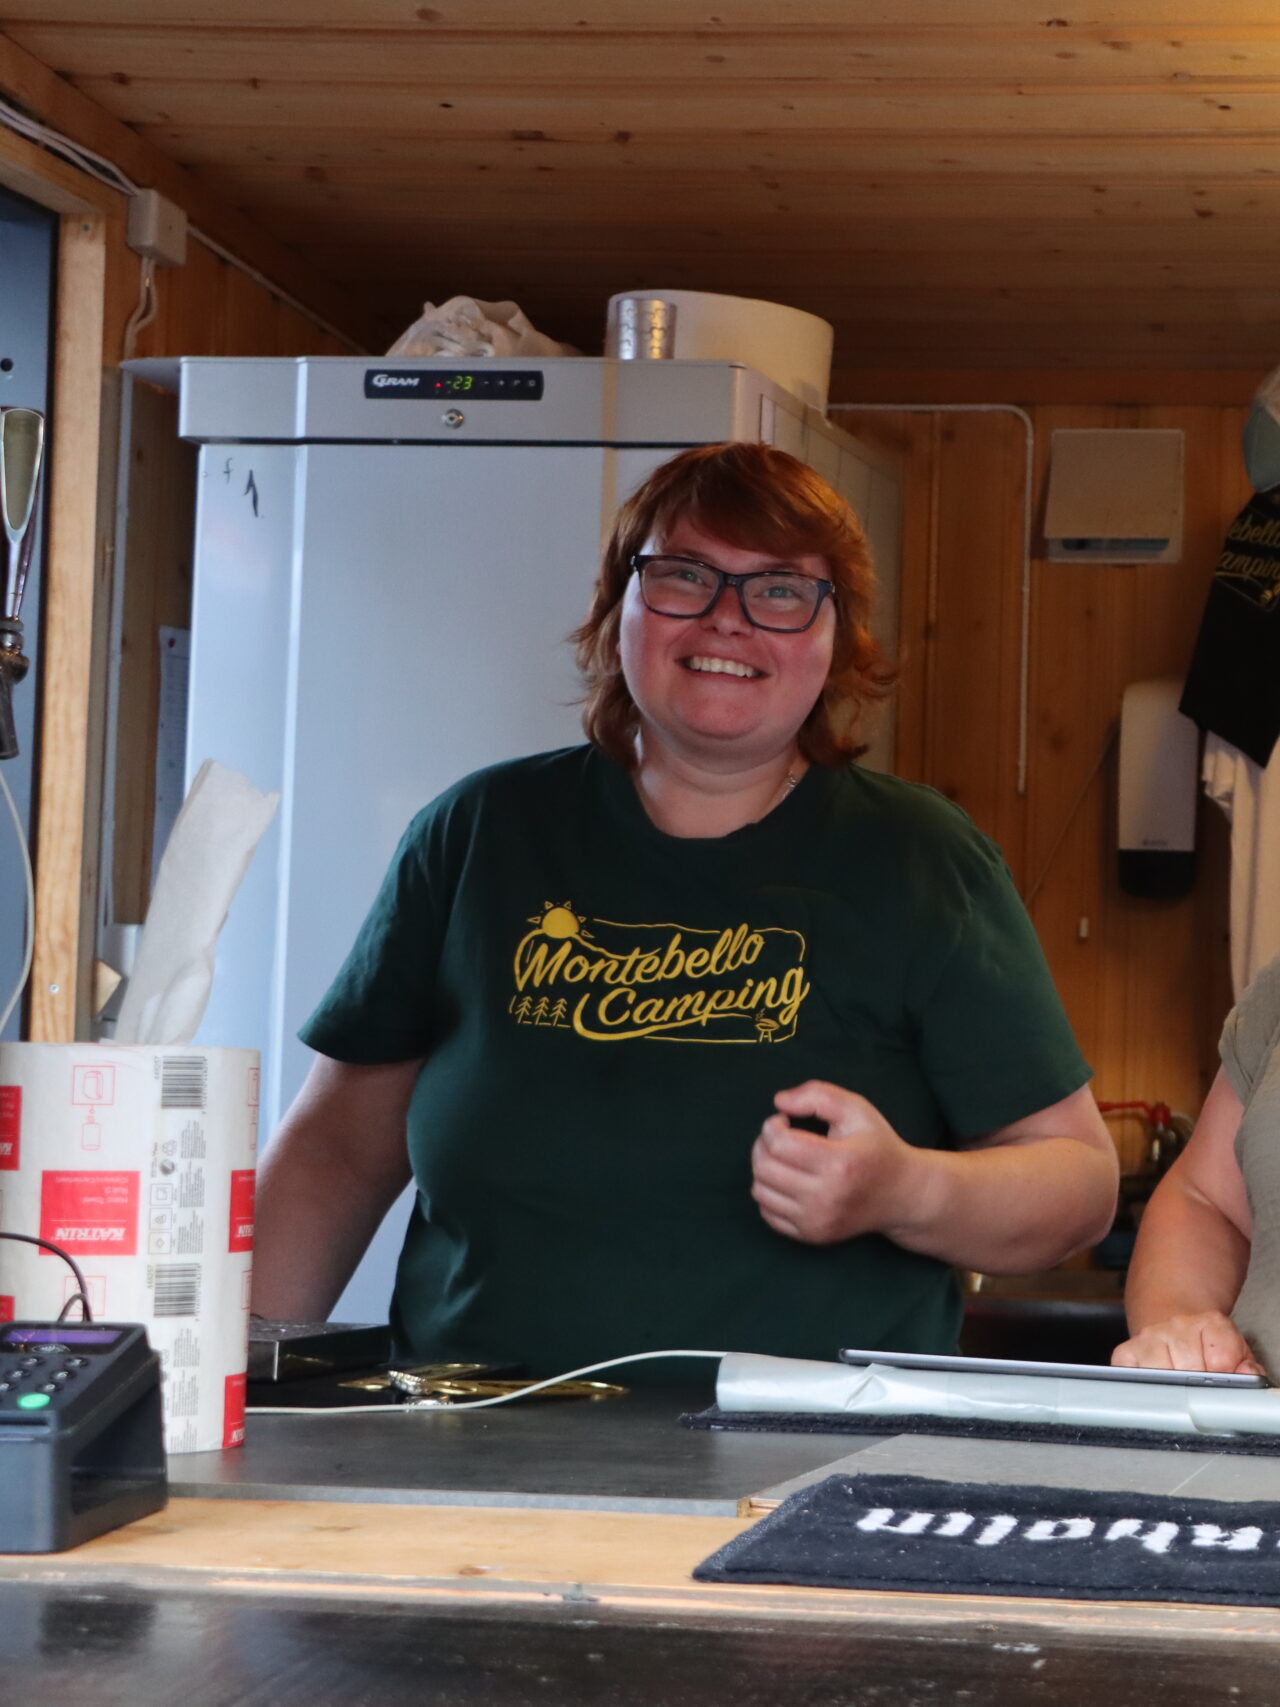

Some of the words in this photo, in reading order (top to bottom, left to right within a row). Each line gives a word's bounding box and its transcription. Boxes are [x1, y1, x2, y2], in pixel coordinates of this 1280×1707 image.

[514, 922, 766, 991] Montebello
[586, 966, 811, 1032] Camping
[54, 1227, 127, 1241] KATRIN
